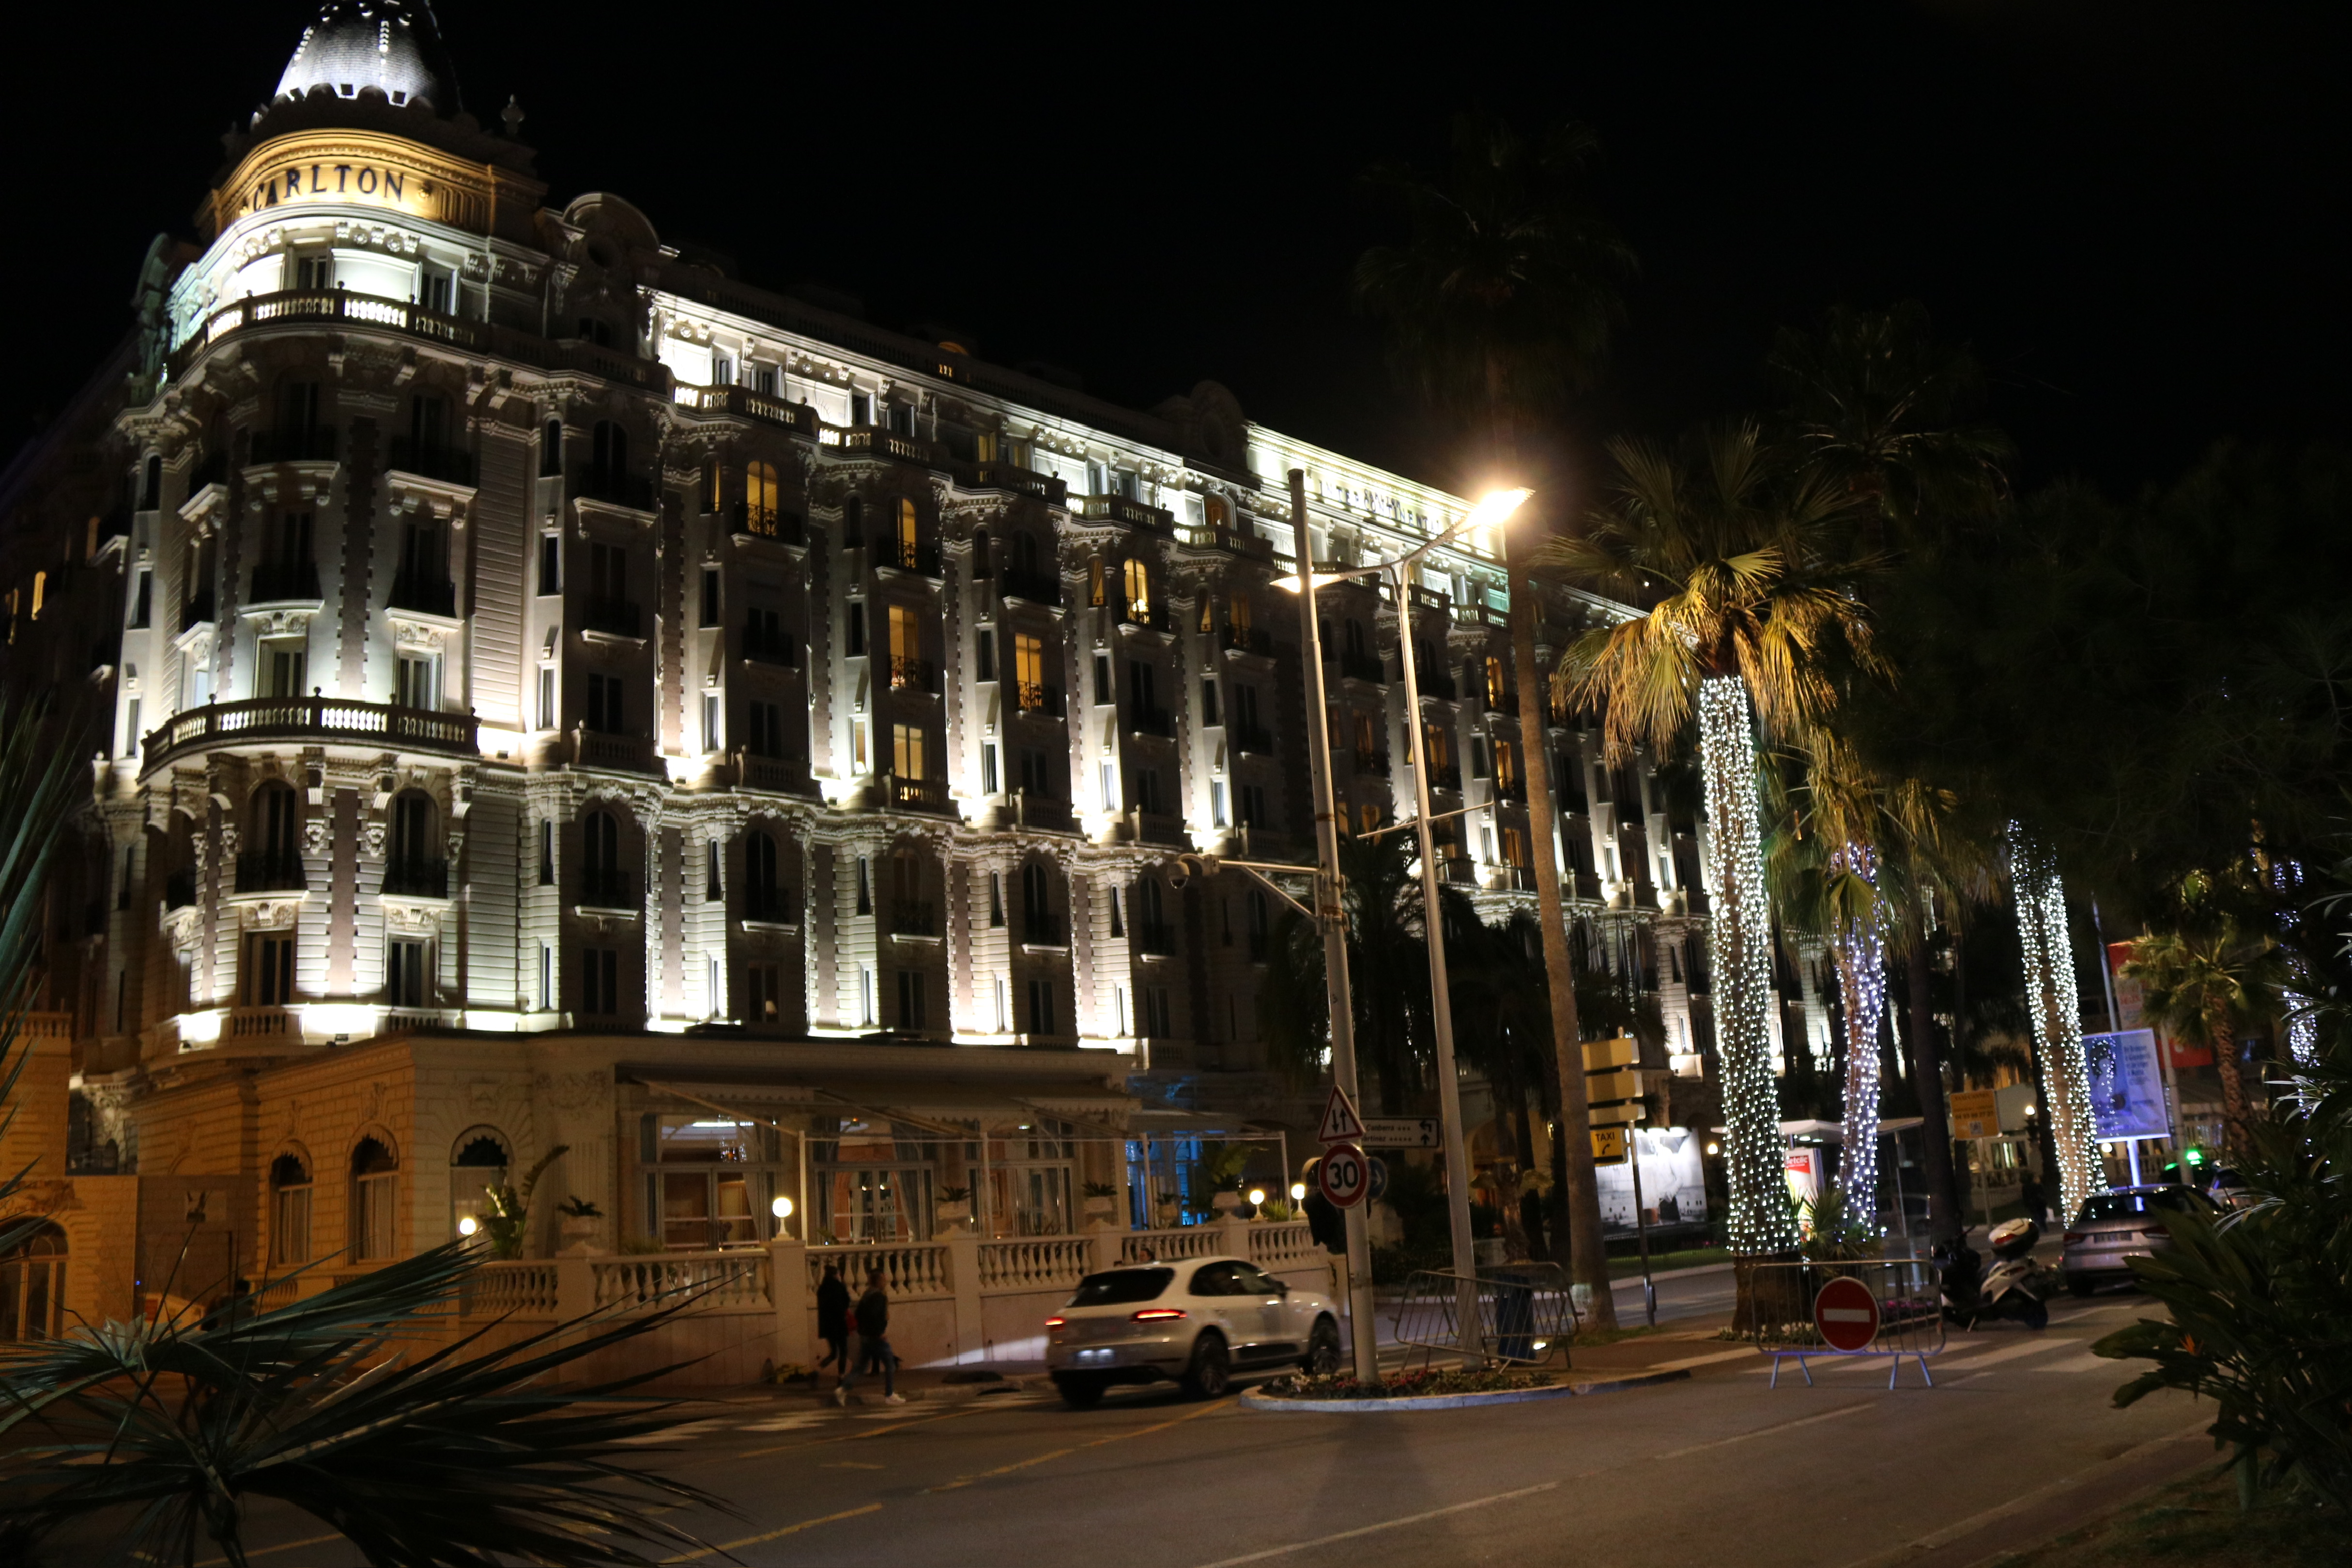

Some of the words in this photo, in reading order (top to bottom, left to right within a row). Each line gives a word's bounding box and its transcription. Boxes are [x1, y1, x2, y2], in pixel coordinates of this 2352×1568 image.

[253, 165, 404, 212] CARLTON
[1361, 1134, 1386, 1142] artinez
[1595, 1132, 1615, 1142] TAXI
[1329, 1161, 1358, 1189] 30
